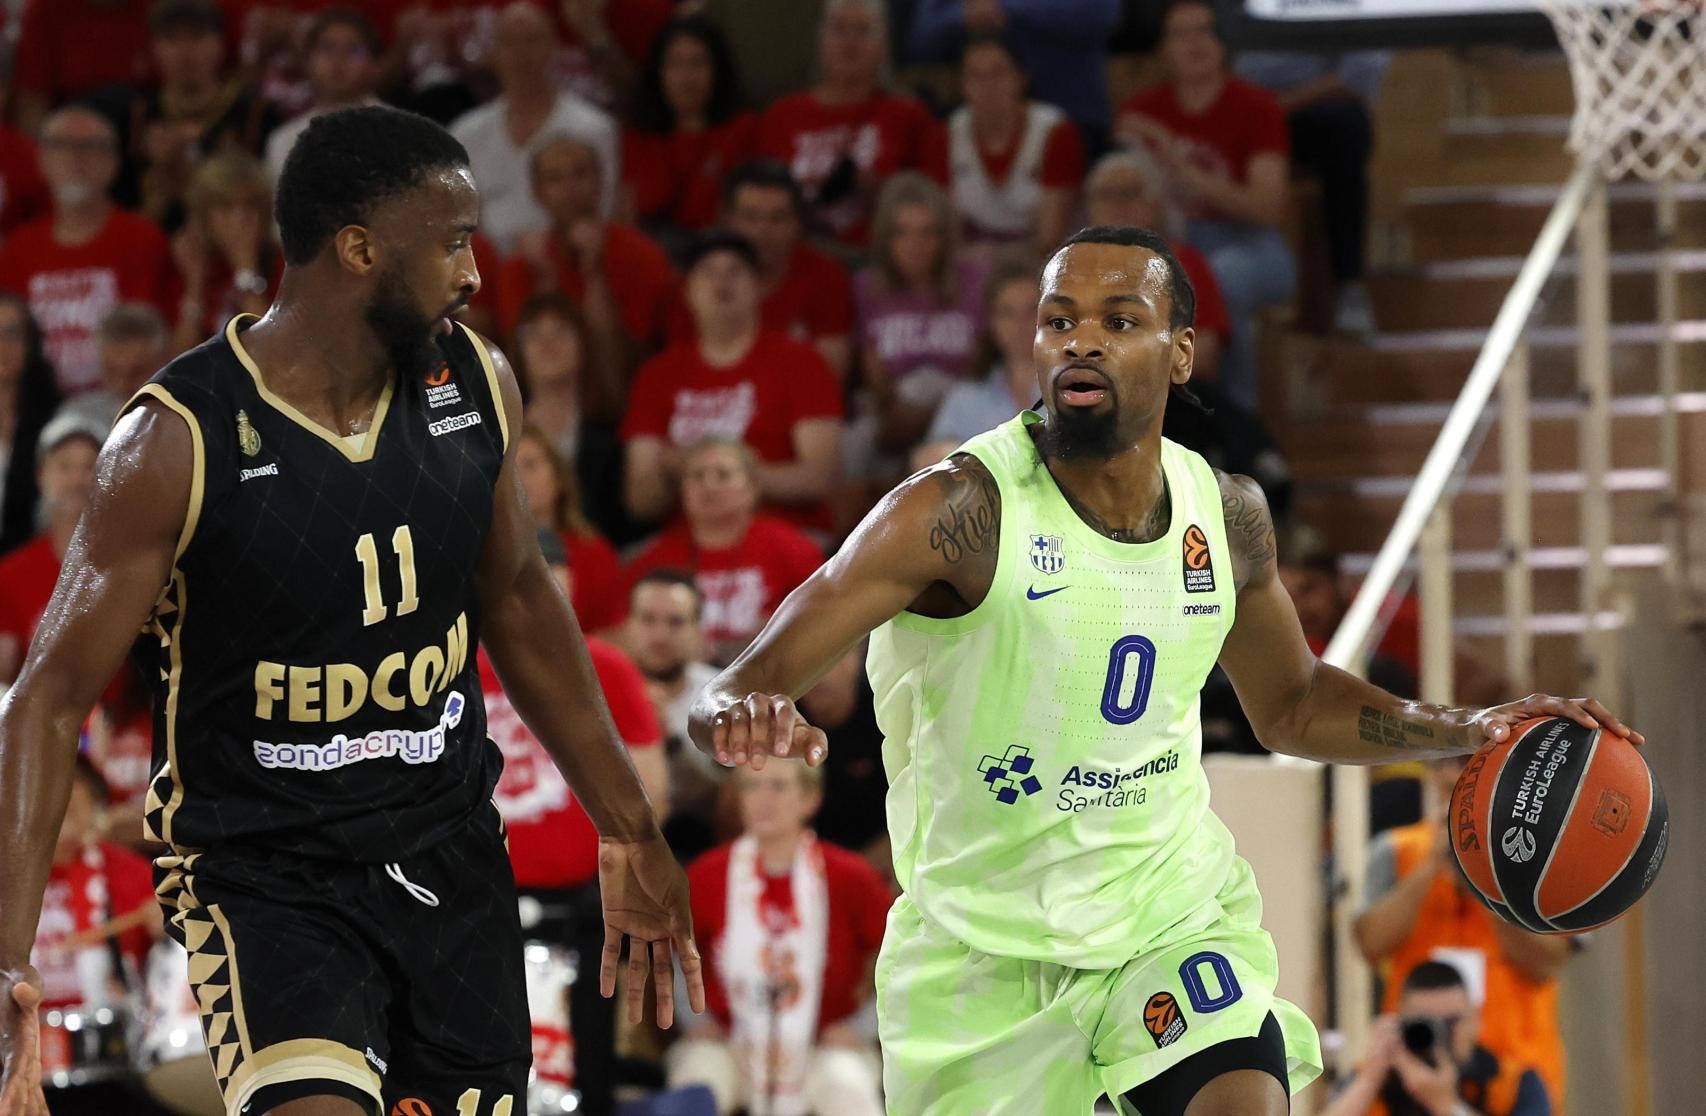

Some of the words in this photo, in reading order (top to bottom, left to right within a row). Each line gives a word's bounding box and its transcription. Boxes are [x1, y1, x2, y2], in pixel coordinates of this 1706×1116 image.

[425, 383, 457, 395] TURKISH
[428, 389, 460, 403] AIRLINES
[429, 412, 481, 436] oneteam
[355, 525, 419, 626] 11
[1186, 569, 1211, 577] TURKISH
[1184, 604, 1220, 615] oneteam
[255, 611, 468, 722] FEDCOM
[1101, 635, 1156, 725] 0
[1512, 760, 1542, 818] TURKISH
[1536, 722, 1570, 759] AIRLINES
[1524, 739, 1572, 825] EuroLeague
[1178, 951, 1243, 1013] 0
